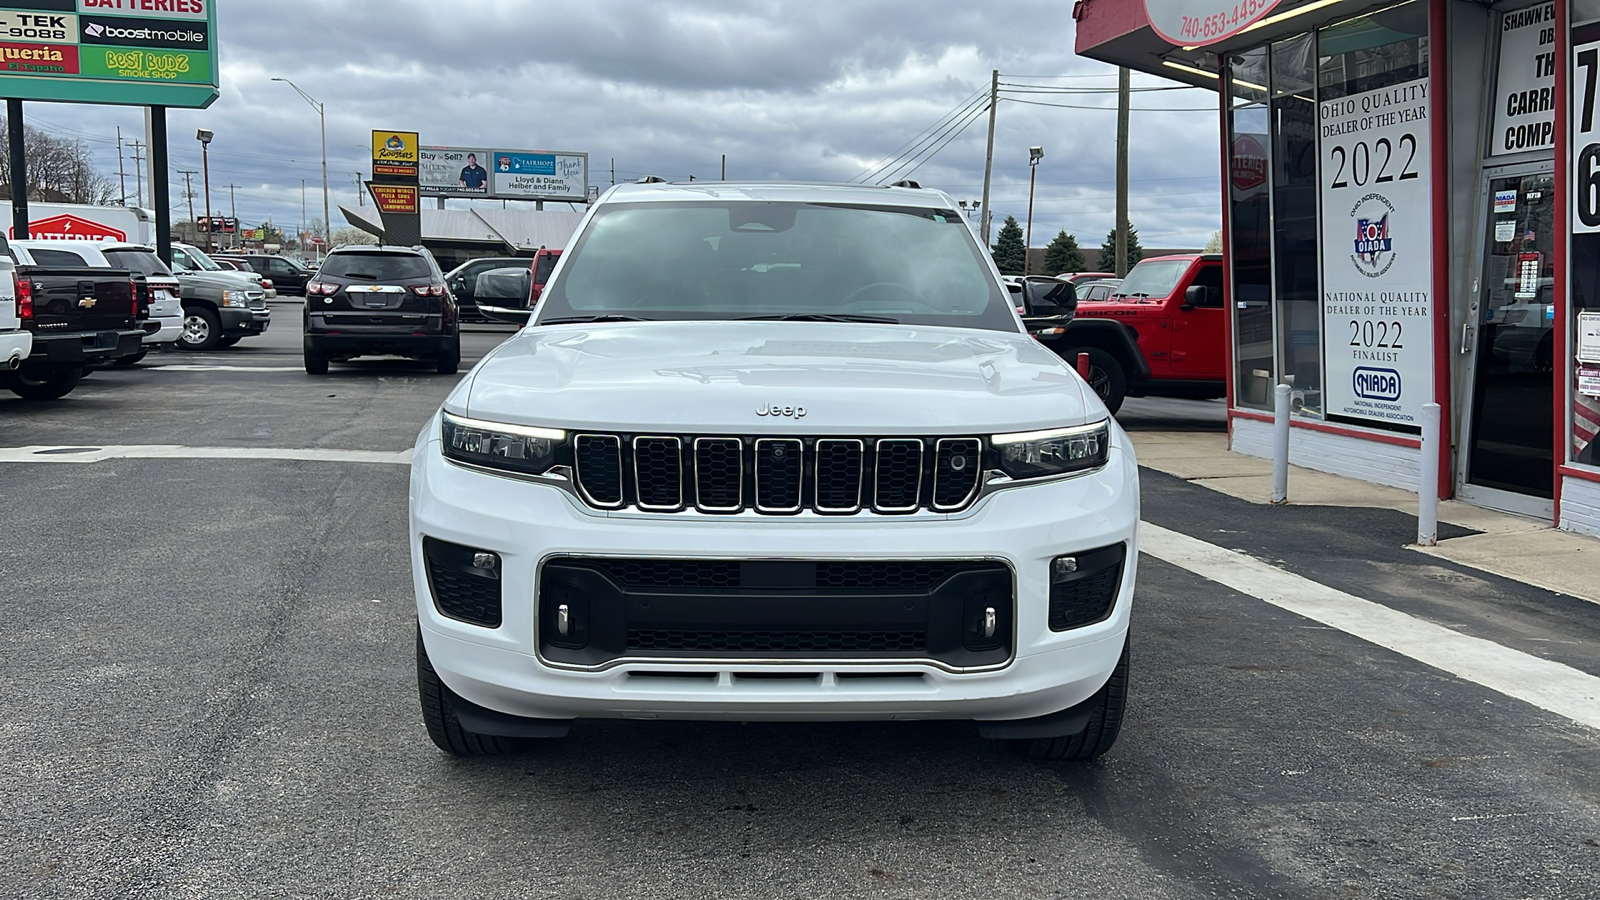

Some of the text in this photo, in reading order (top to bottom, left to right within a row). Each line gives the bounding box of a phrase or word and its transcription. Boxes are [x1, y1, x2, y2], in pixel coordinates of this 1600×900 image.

[16, 14, 67, 29] TEK
[1503, 7, 1542, 32] SHAWN
[105, 25, 204, 42] boostmobile
[8, 62, 20, 70] El
[146, 52, 189, 73] BUDZ
[1534, 51, 1555, 79] TH
[118, 69, 178, 79] SMOKE SHOP
[1577, 47, 1599, 134] 7
[1321, 82, 1428, 120] OHIO QUALITY
[1322, 105, 1427, 139] DEALER OF THE YEAR
[378, 147, 414, 159] Roosters
[420, 152, 436, 161] Buy
[444, 153, 463, 161] Sell?
[522, 159, 554, 167] FAIRHOPE
[557, 157, 582, 171] Thank
[1330, 133, 1419, 189] 2022
[563, 167, 581, 179] You
[508, 182, 532, 190] Helber
[547, 184, 571, 193] Family
[515, 176, 535, 184] Lloyd
[543, 177, 564, 185] Diann
[1350, 192, 1396, 218] OHIO INDEPENDENT
[1358, 239, 1386, 253] OIADA
[1326, 291, 1429, 304] NATIONAL QUALITY
[1327, 305, 1428, 317] DEALER OF THE YEAR
[1349, 320, 1403, 349] 2022
[1353, 350, 1399, 363] FINALIST
[1356, 373, 1397, 394] NIADA
[755, 401, 807, 420] Jeep
[1354, 400, 1402, 411] NATIONAL INDEPENDENT
[1343, 407, 1367, 416] AUTOMOBILE
[1386, 412, 1415, 421] ASSOCIATION
